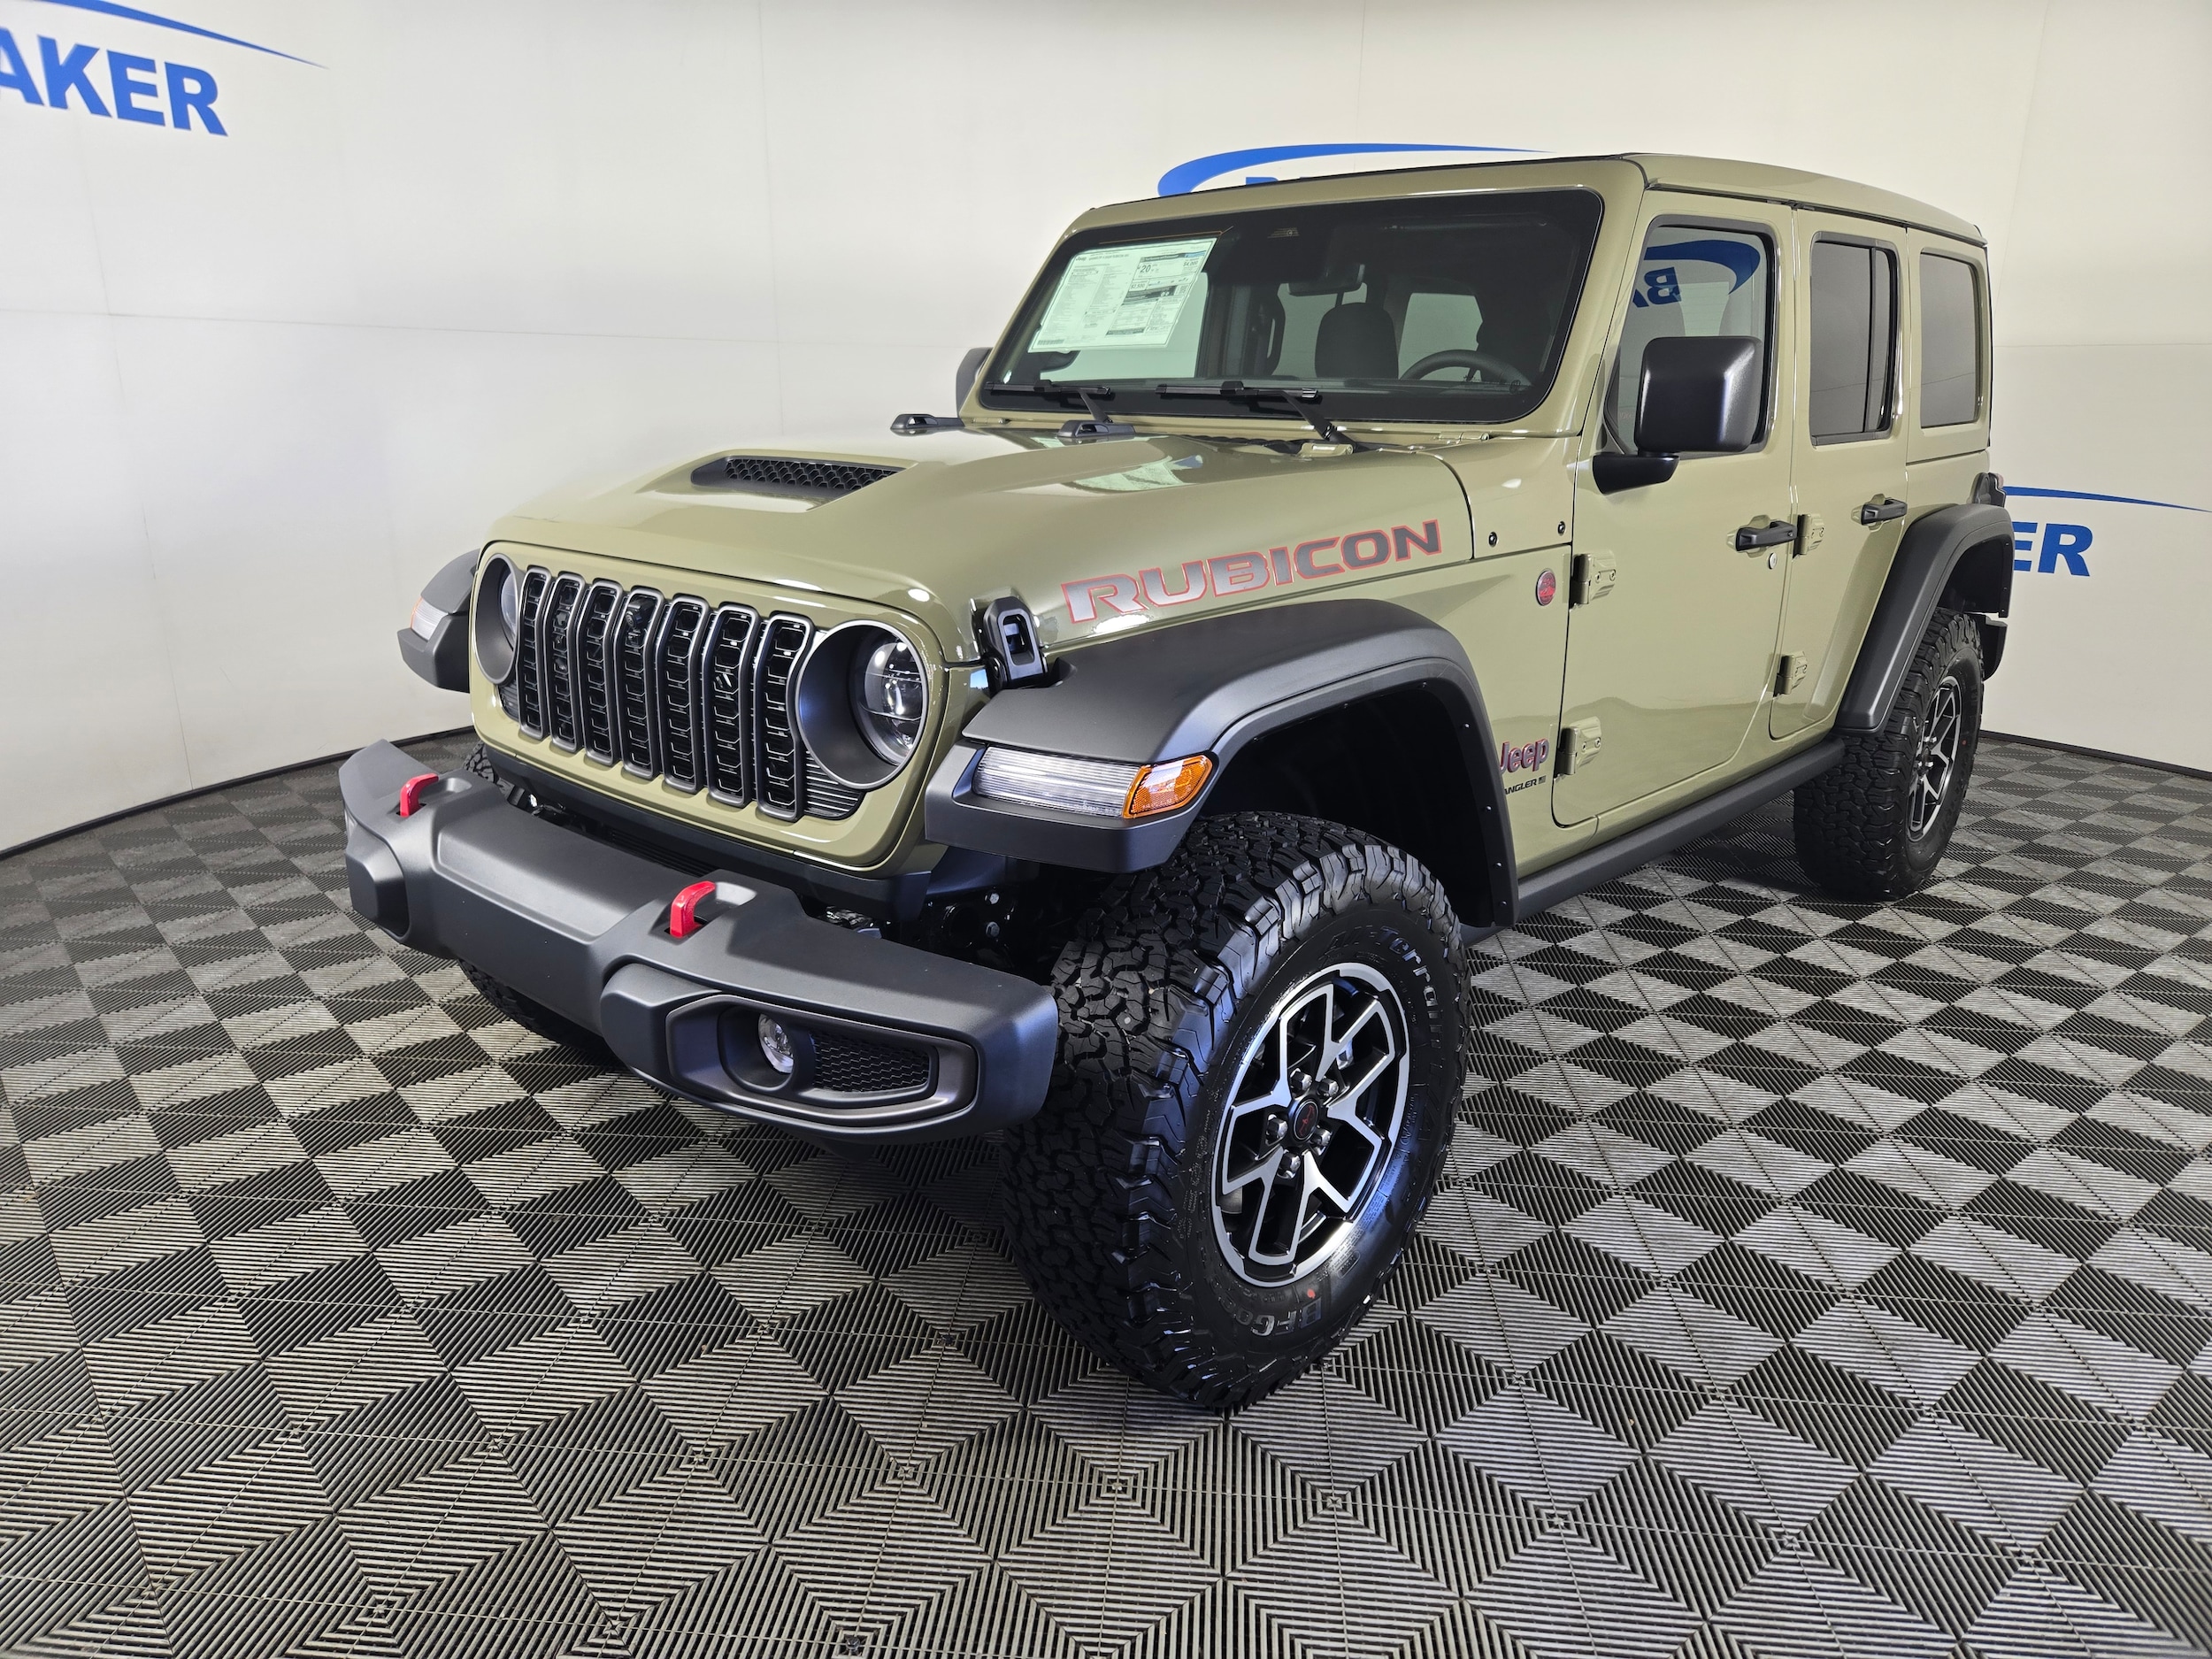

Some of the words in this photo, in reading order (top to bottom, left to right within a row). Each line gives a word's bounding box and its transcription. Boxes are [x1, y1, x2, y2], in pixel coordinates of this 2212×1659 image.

[1140, 265, 1151, 273] 20
[1061, 518, 1441, 624] RUBICON
[1500, 738, 1549, 774] Jeep
